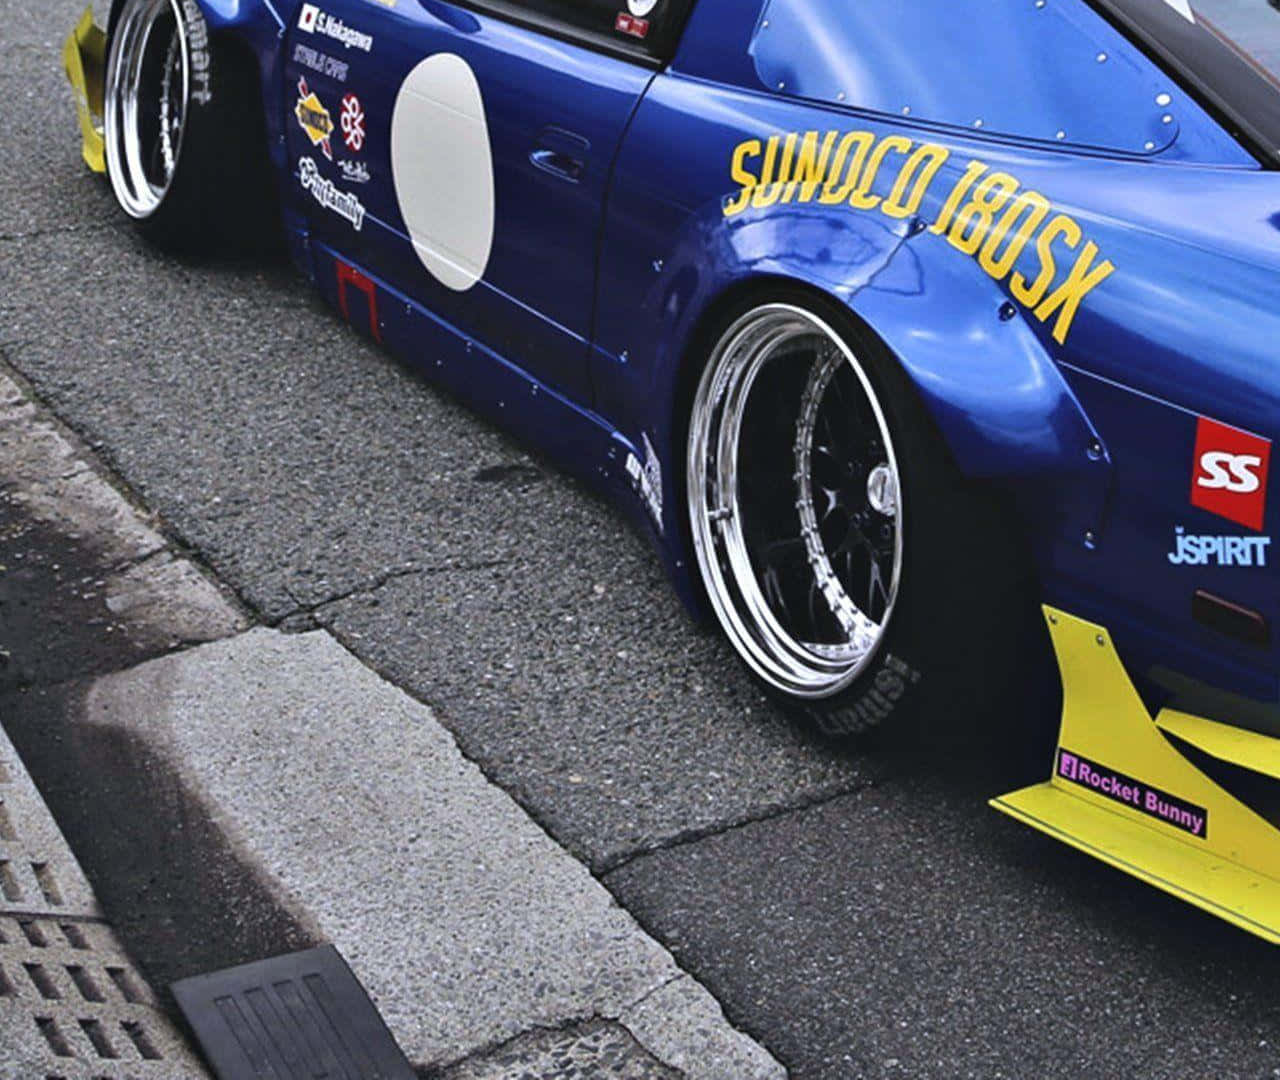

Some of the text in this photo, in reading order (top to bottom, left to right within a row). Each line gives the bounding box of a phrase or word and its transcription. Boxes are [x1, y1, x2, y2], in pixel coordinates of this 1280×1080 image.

[722, 130, 1116, 346] SUNOCO 180SX
[1197, 451, 1261, 493] SS
[1078, 762, 1141, 805] Rocket
[1145, 790, 1204, 835] Bunny
